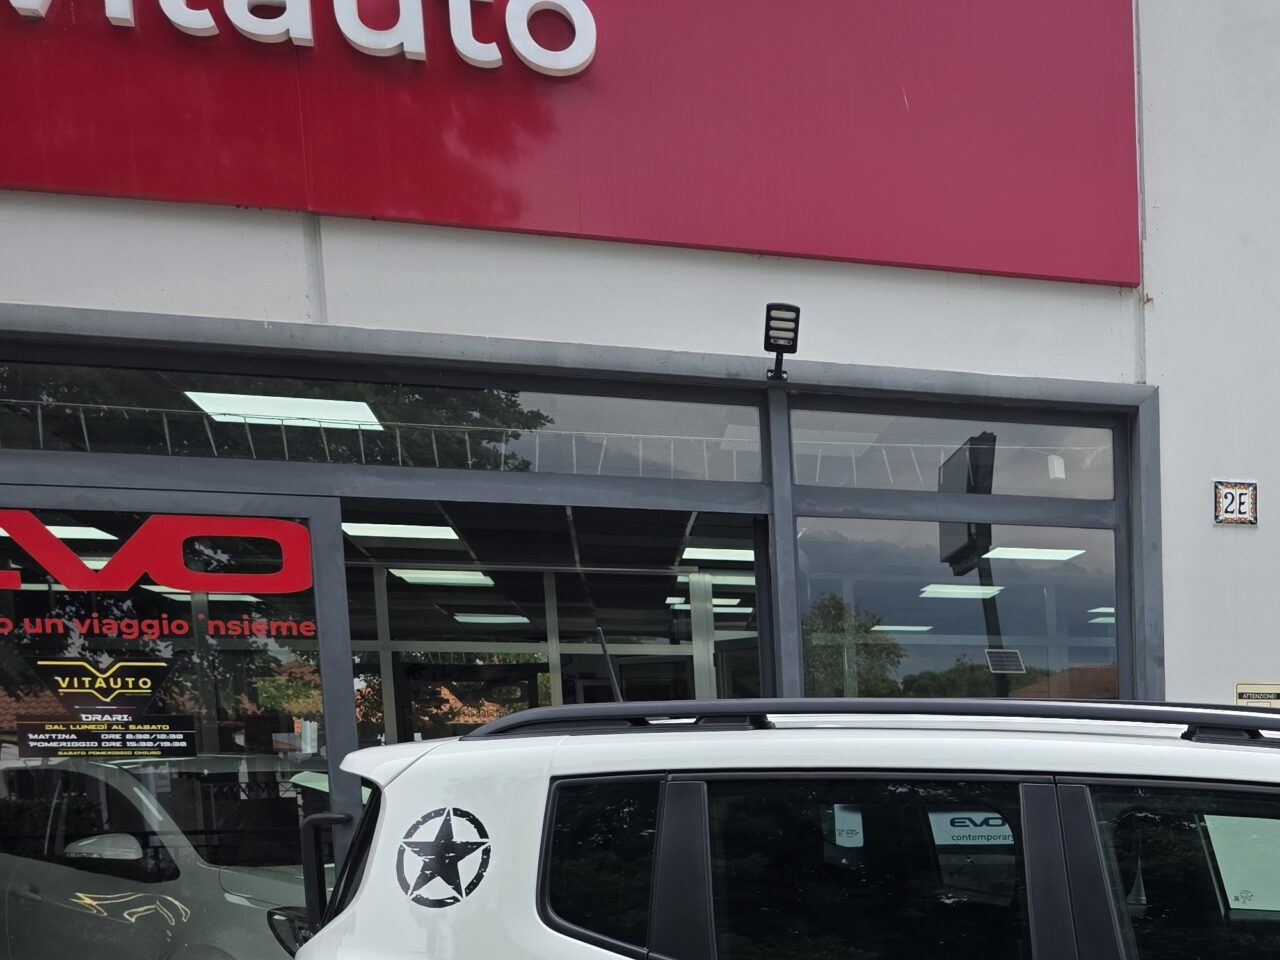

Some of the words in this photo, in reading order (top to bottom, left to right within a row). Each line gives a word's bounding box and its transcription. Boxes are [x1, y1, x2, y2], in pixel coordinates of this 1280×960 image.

[8, 0, 598, 77] auto
[1223, 491, 1248, 515] 2E
[0, 509, 313, 594] VO
[23, 617, 64, 634] un
[73, 612, 190, 640] viaggio
[54, 676, 152, 688] VITAUTO
[949, 817, 1007, 827] EVO
